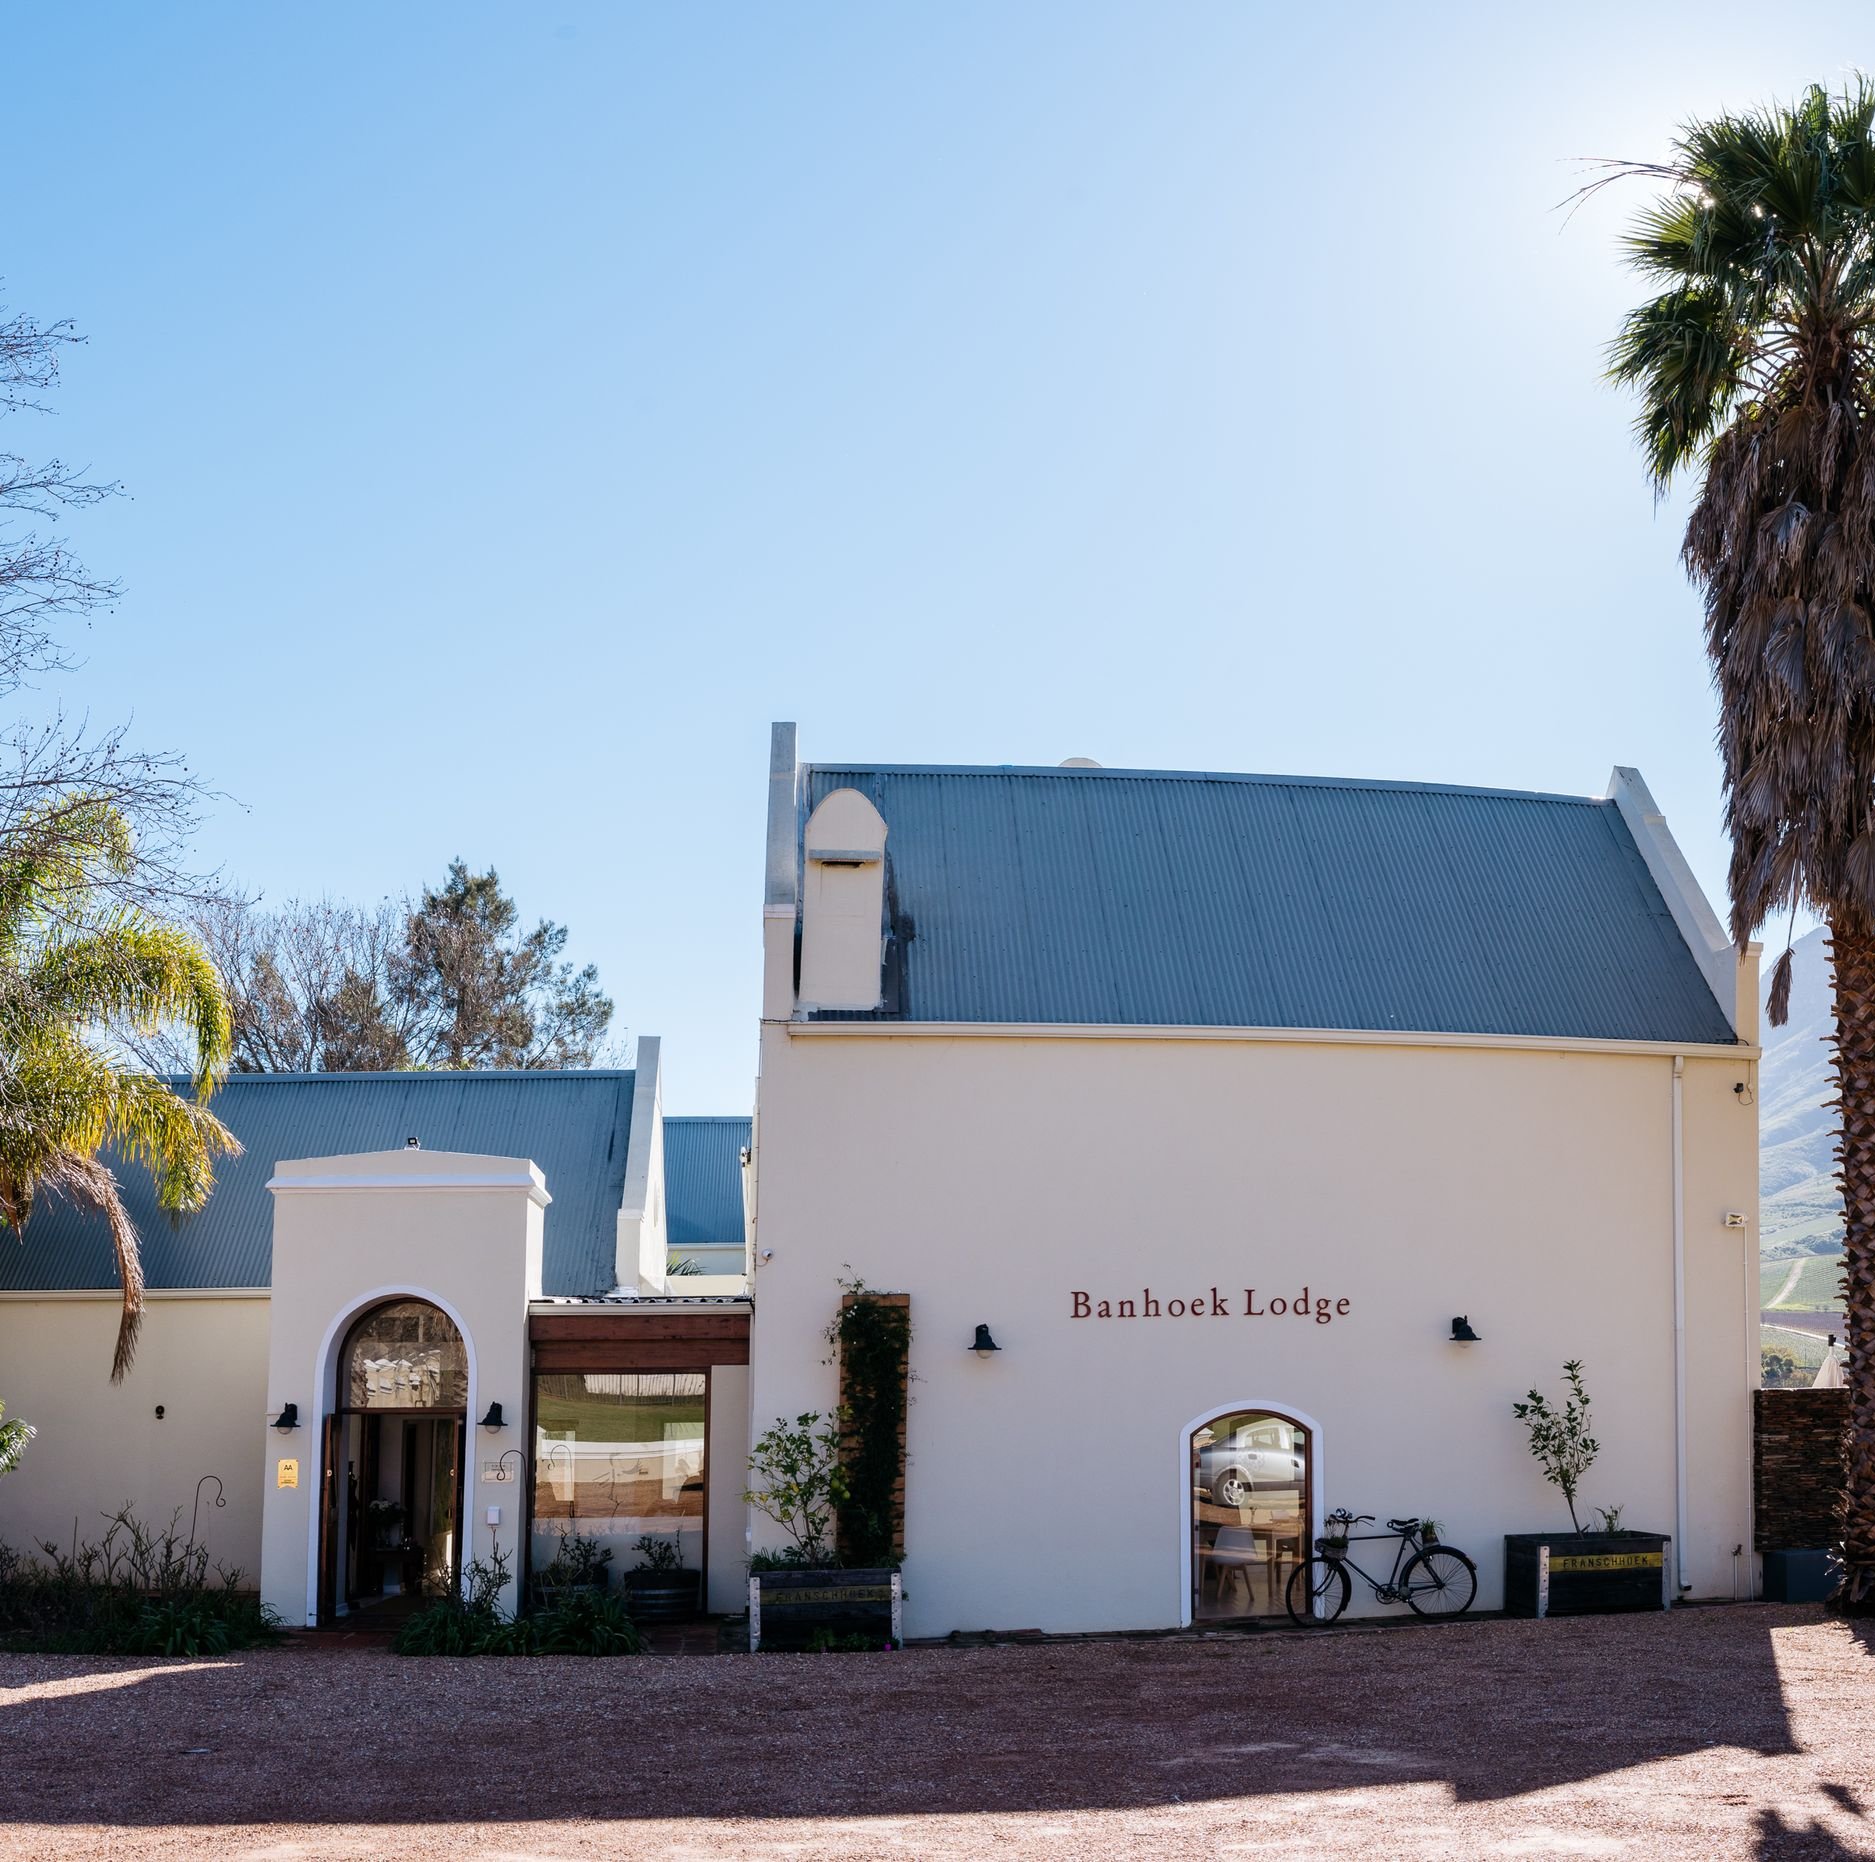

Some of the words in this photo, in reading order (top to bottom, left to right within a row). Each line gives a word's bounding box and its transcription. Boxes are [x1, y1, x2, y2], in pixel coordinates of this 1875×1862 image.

[1070, 1287, 1230, 1319] Banhoek
[1243, 1286, 1352, 1325] Lodge
[1562, 1555, 1649, 1569] FRANSCHHOEK
